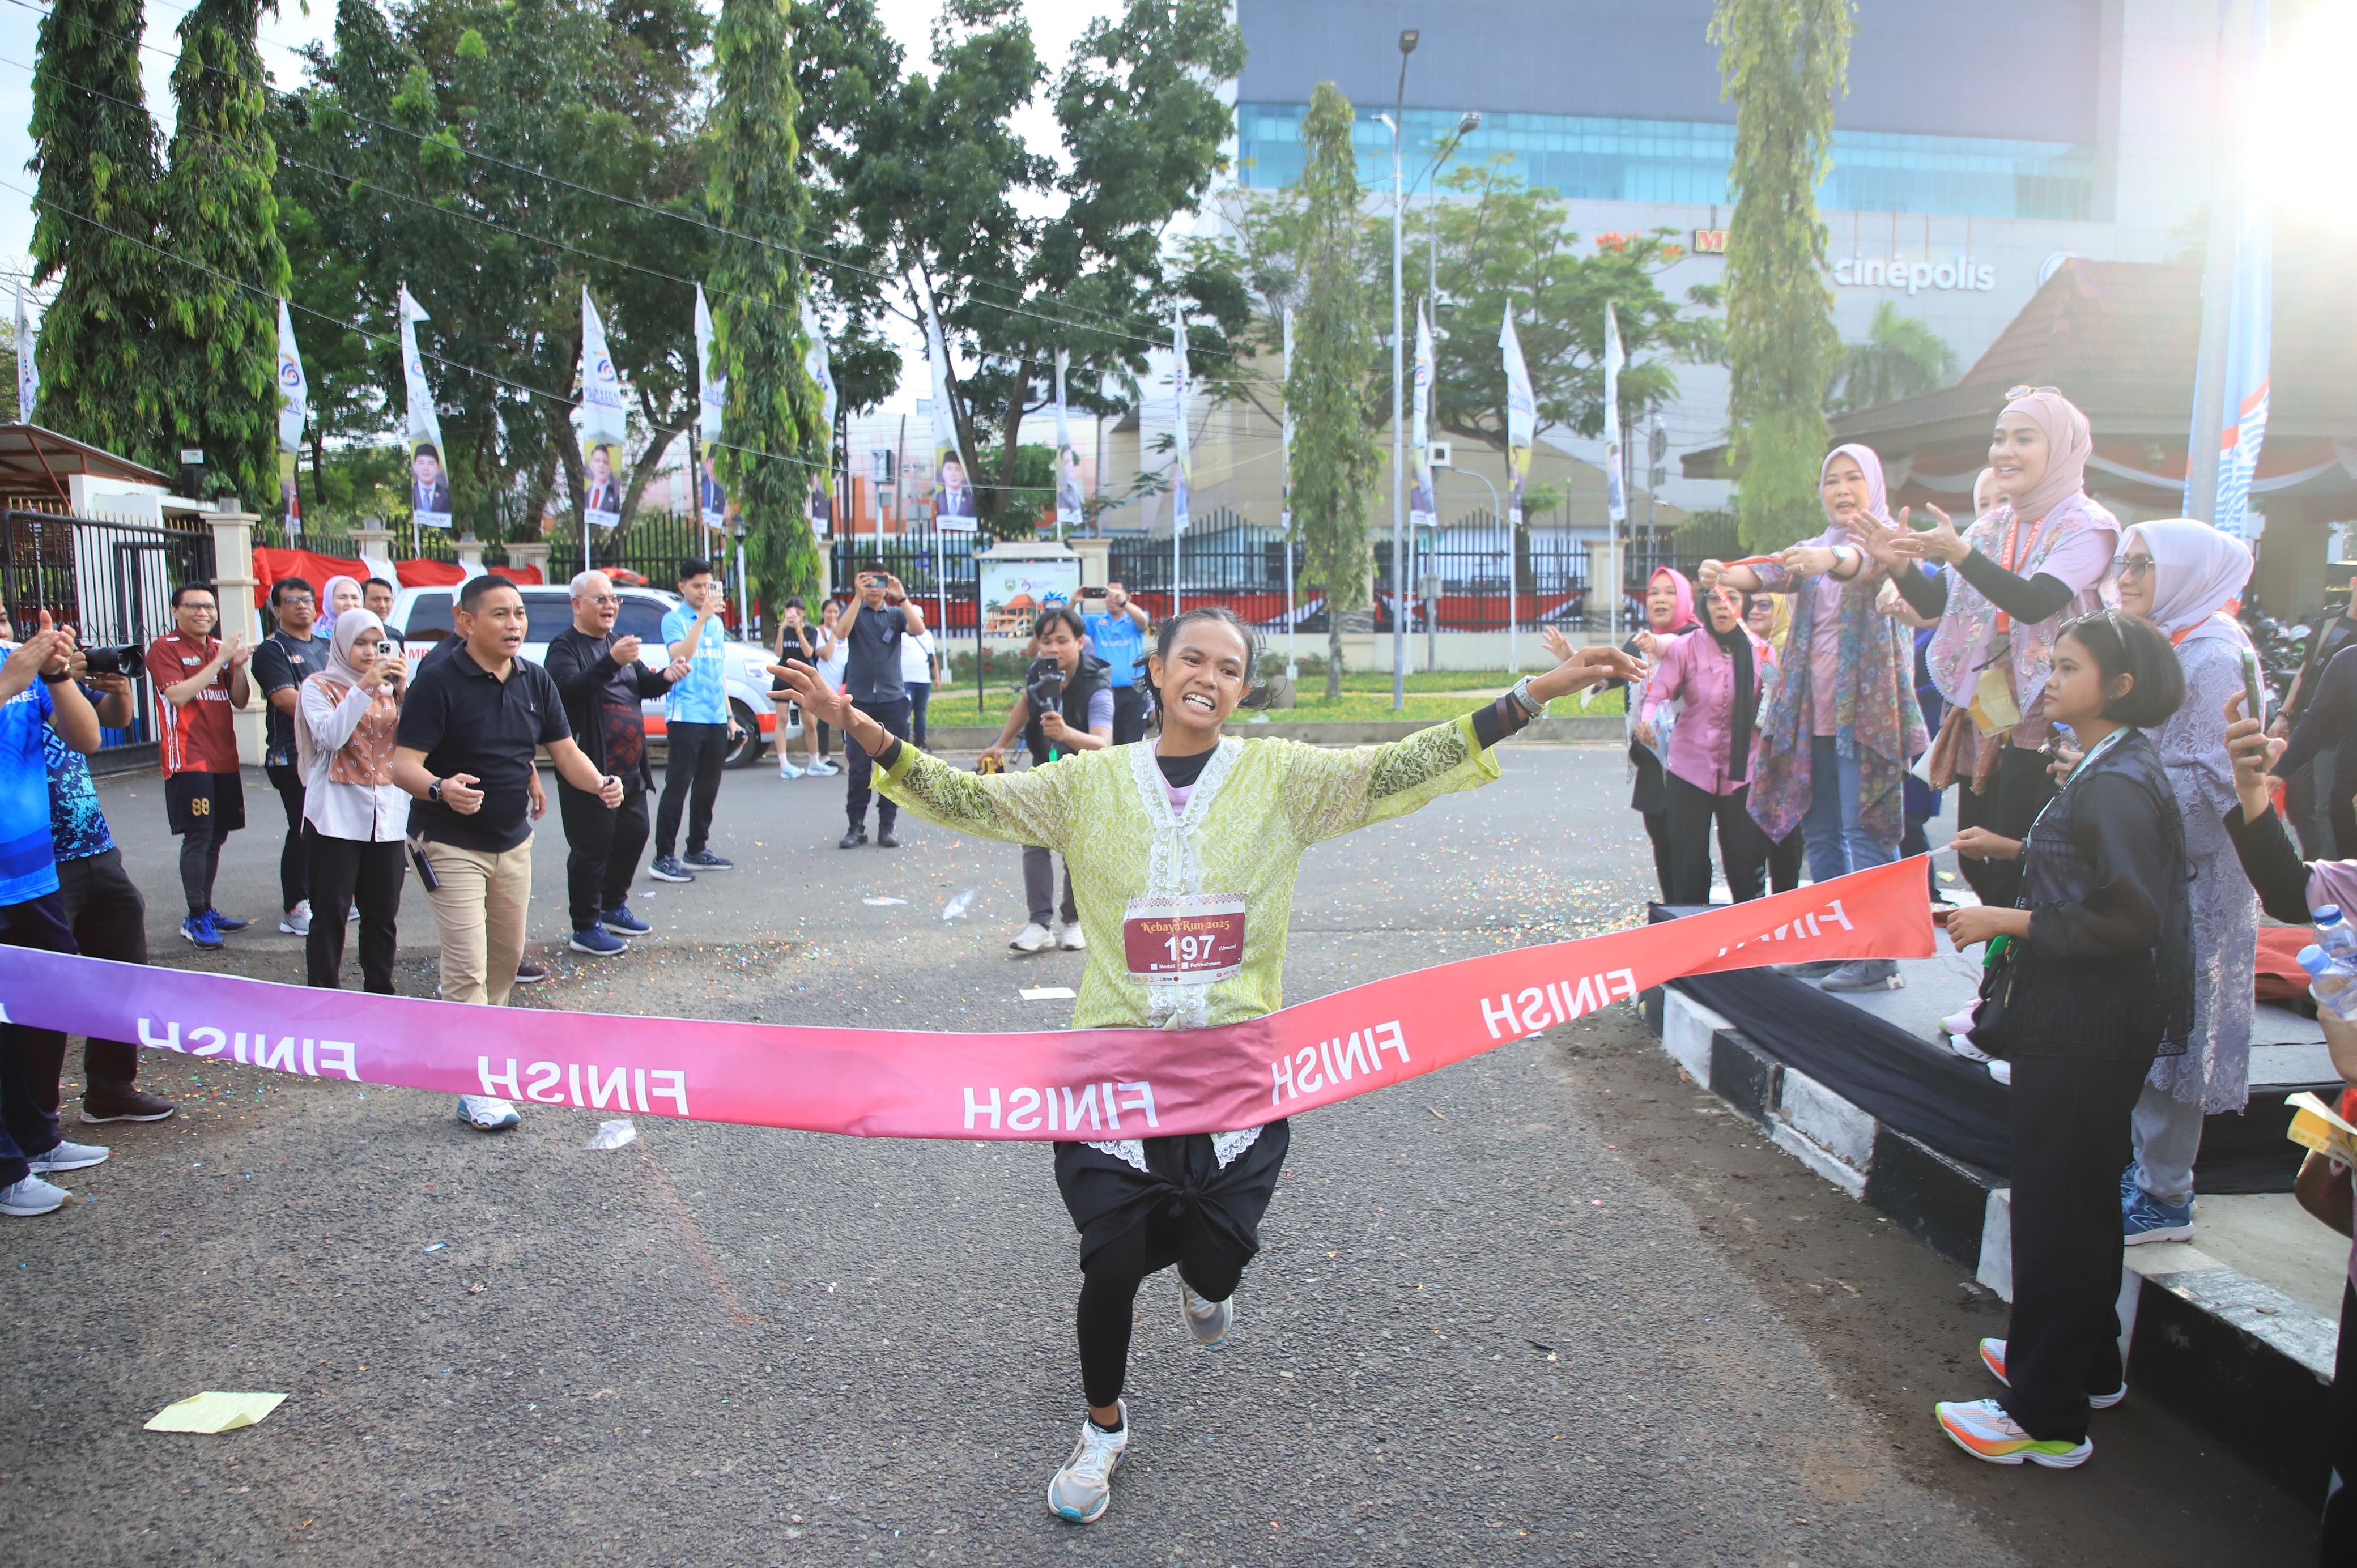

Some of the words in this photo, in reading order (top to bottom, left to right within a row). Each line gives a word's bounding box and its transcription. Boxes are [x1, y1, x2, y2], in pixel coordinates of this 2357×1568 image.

[1833, 252, 1995, 296] cinépolis
[192, 798, 210, 816] 88
[1141, 922, 1180, 934] Kebaya
[1180, 921, 1203, 932] Run
[1207, 921, 1230, 930] 2025
[1164, 935, 1215, 961] 197
